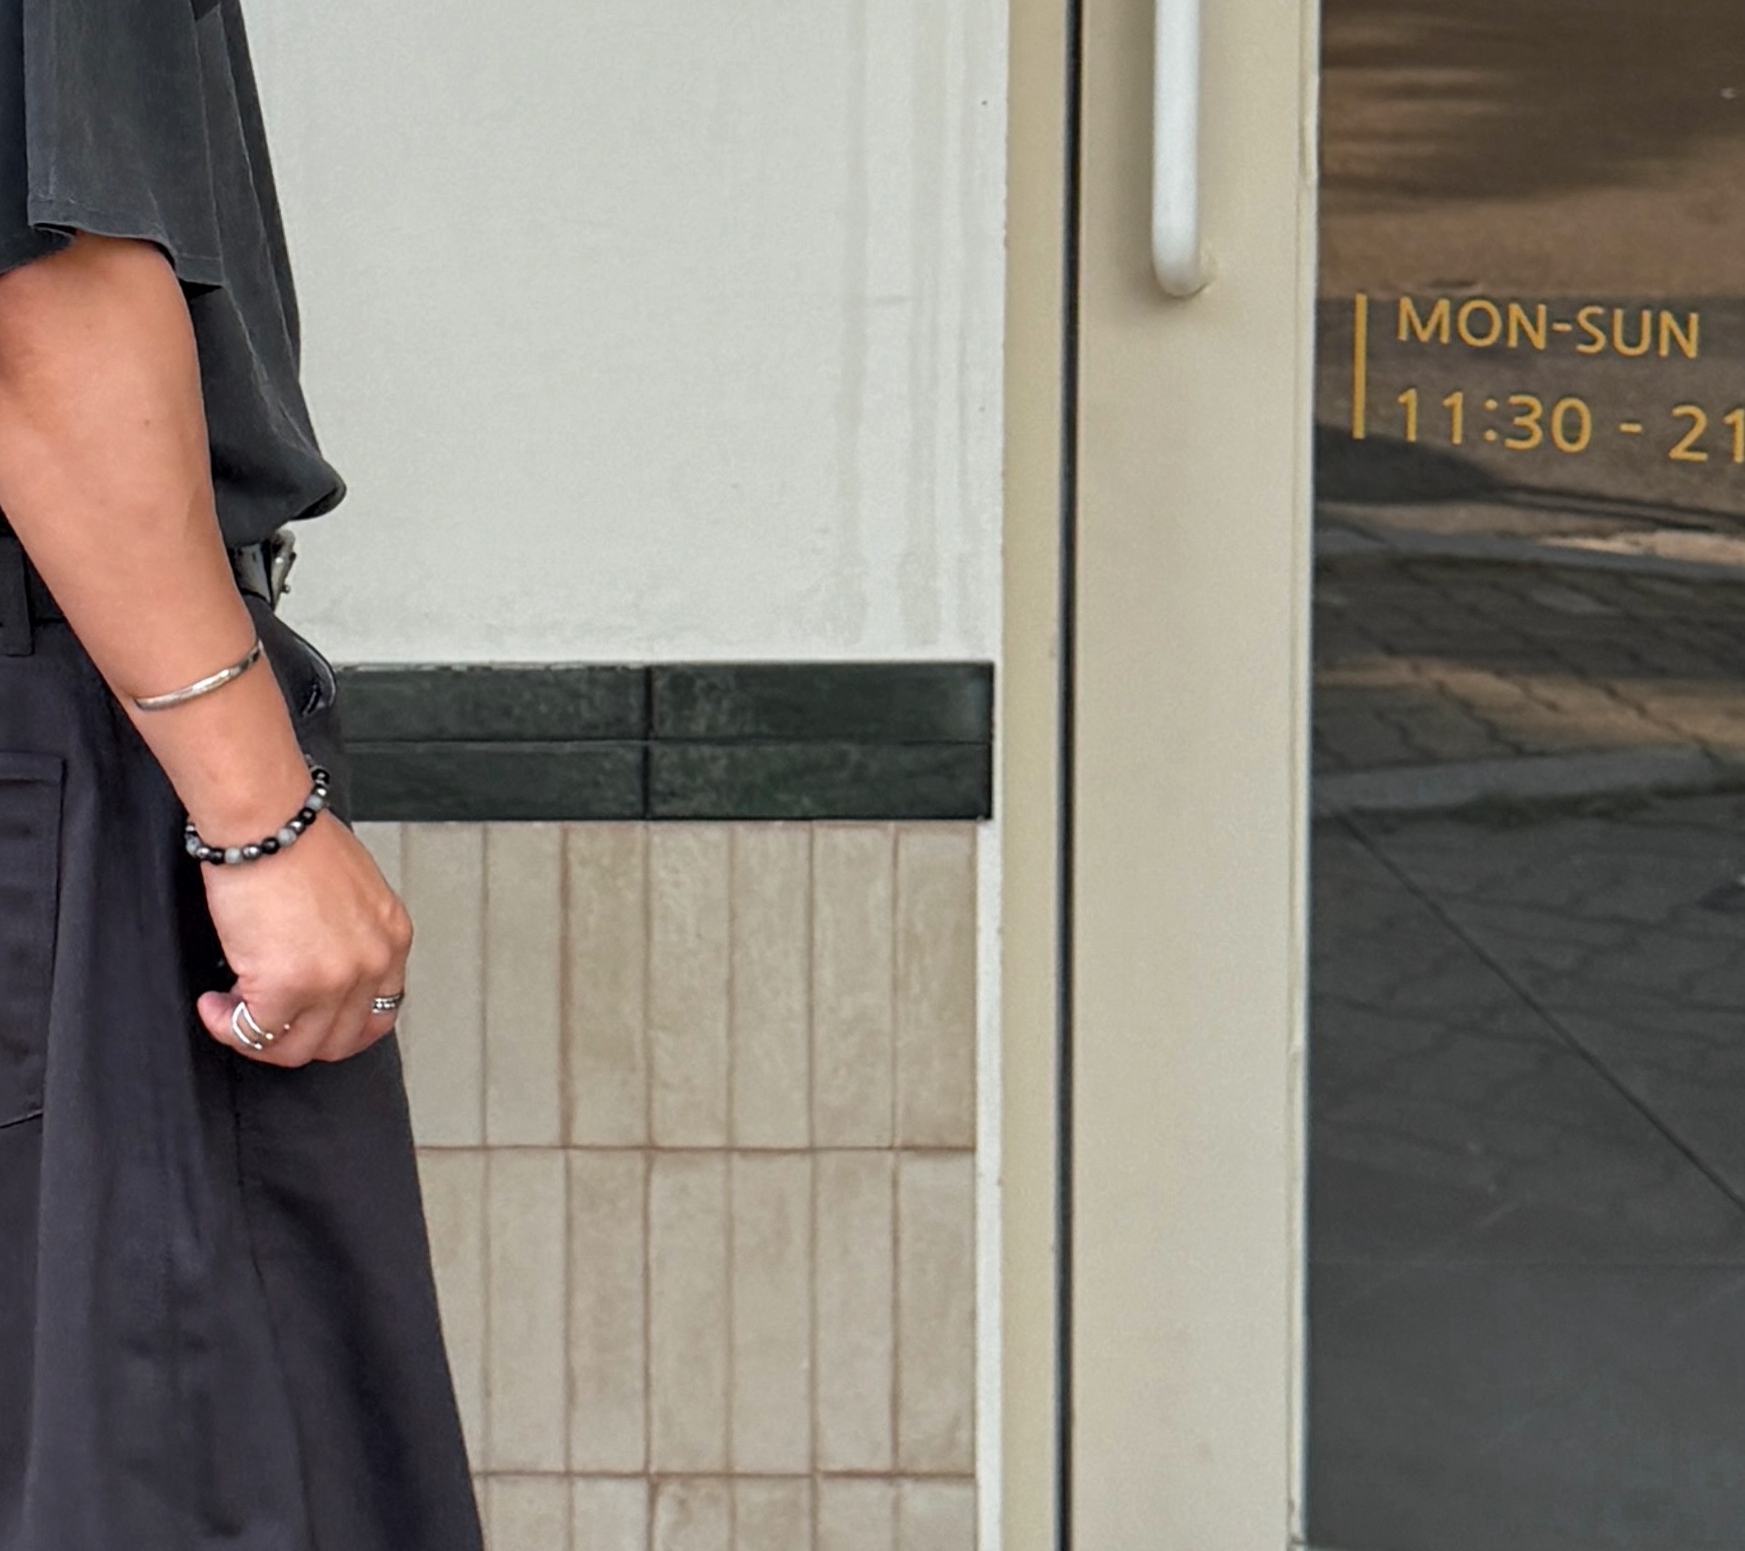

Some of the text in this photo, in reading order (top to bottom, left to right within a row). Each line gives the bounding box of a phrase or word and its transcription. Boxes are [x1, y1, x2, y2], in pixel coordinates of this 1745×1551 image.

[1396, 295, 1700, 359] MON-SUN
[1396, 387, 1593, 454] 11:30
[1618, 422, 1644, 434] -
